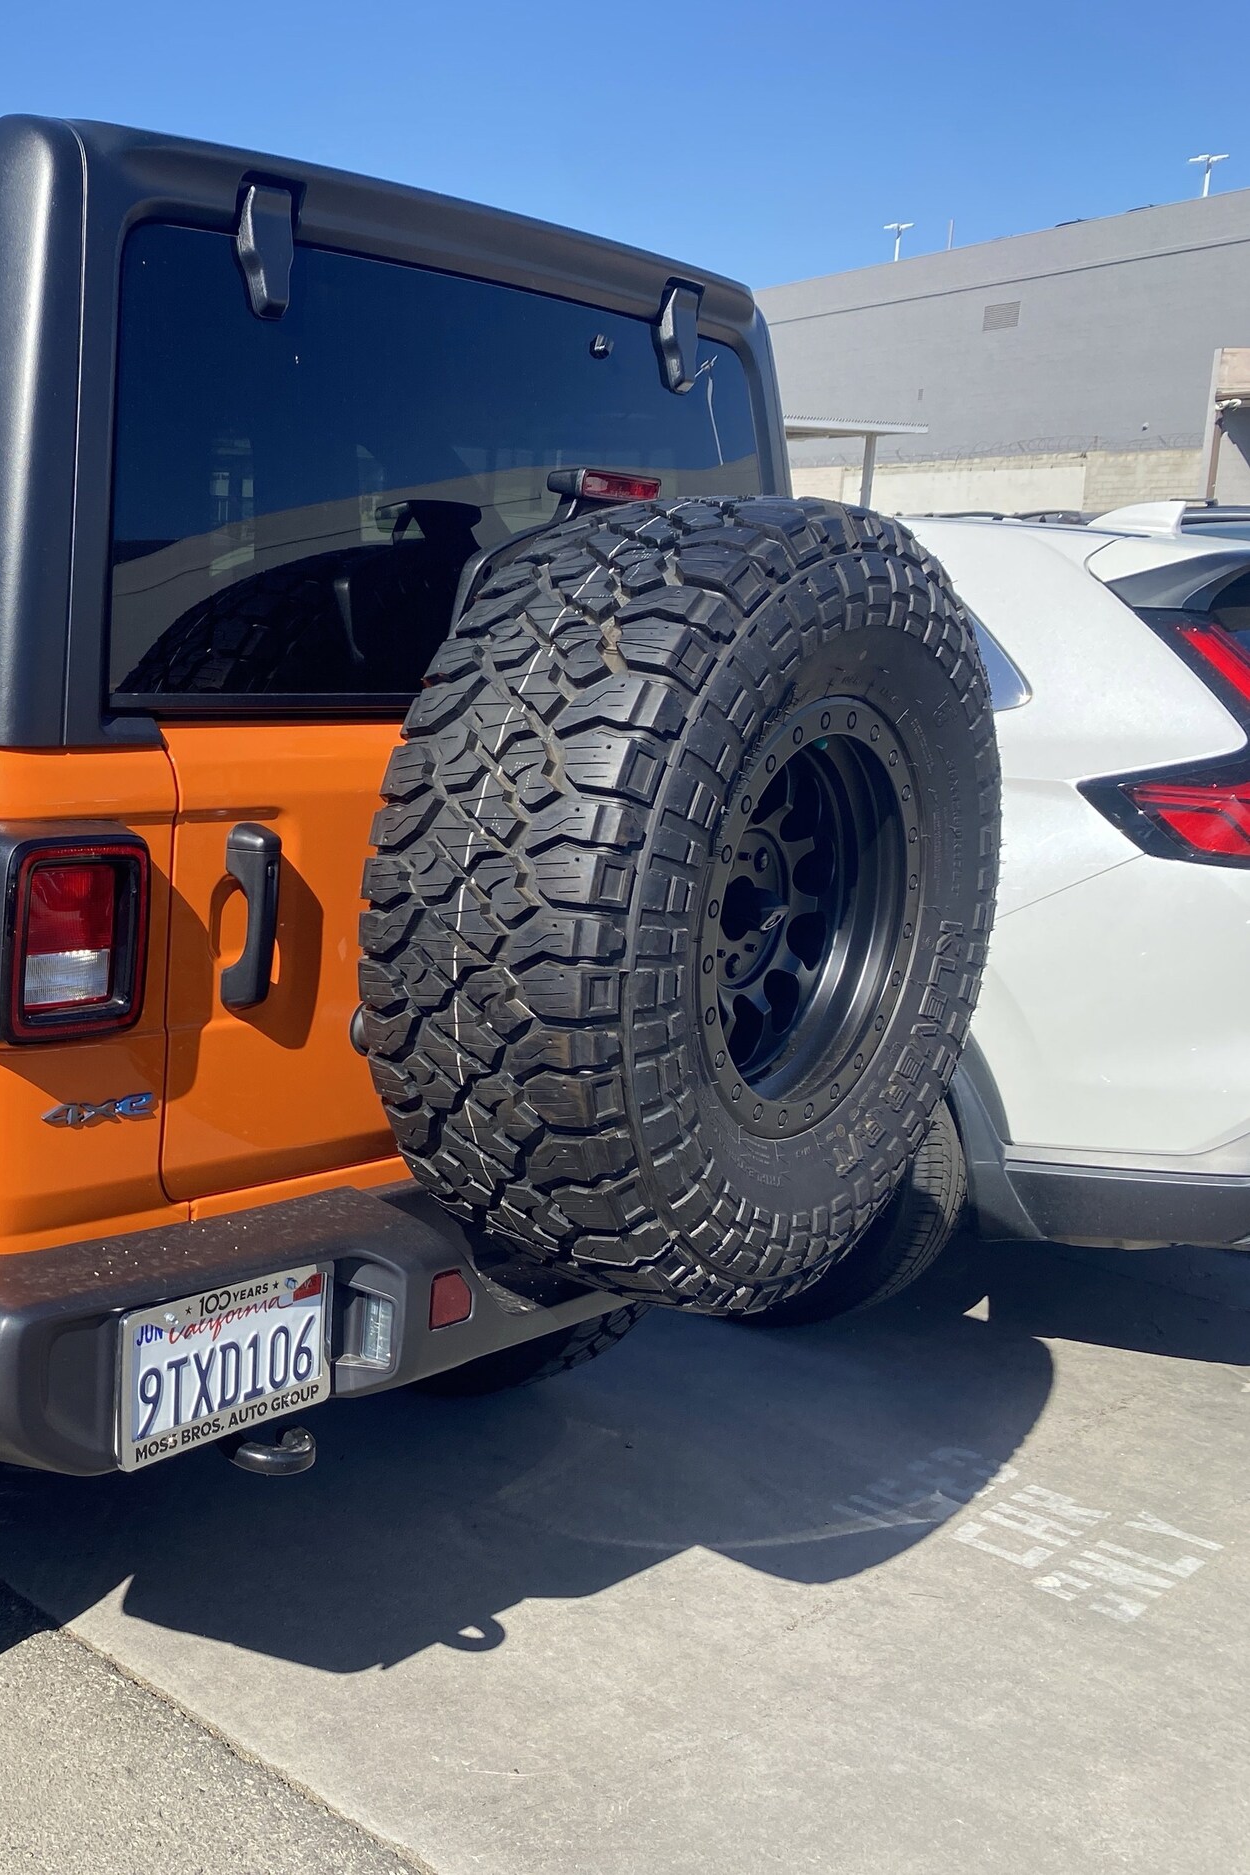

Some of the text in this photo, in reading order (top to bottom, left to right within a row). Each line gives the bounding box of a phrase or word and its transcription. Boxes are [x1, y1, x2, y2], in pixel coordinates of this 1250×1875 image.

[879, 920, 965, 1112] KLEVER
[136, 1324, 164, 1347] JUN
[233, 1283, 269, 1302] YEARS
[135, 1384, 320, 1463] MOSS BROS. AUTO GROUP
[138, 1314, 317, 1441] 9TXD106
[1033, 1510, 1225, 1622] ONLY
